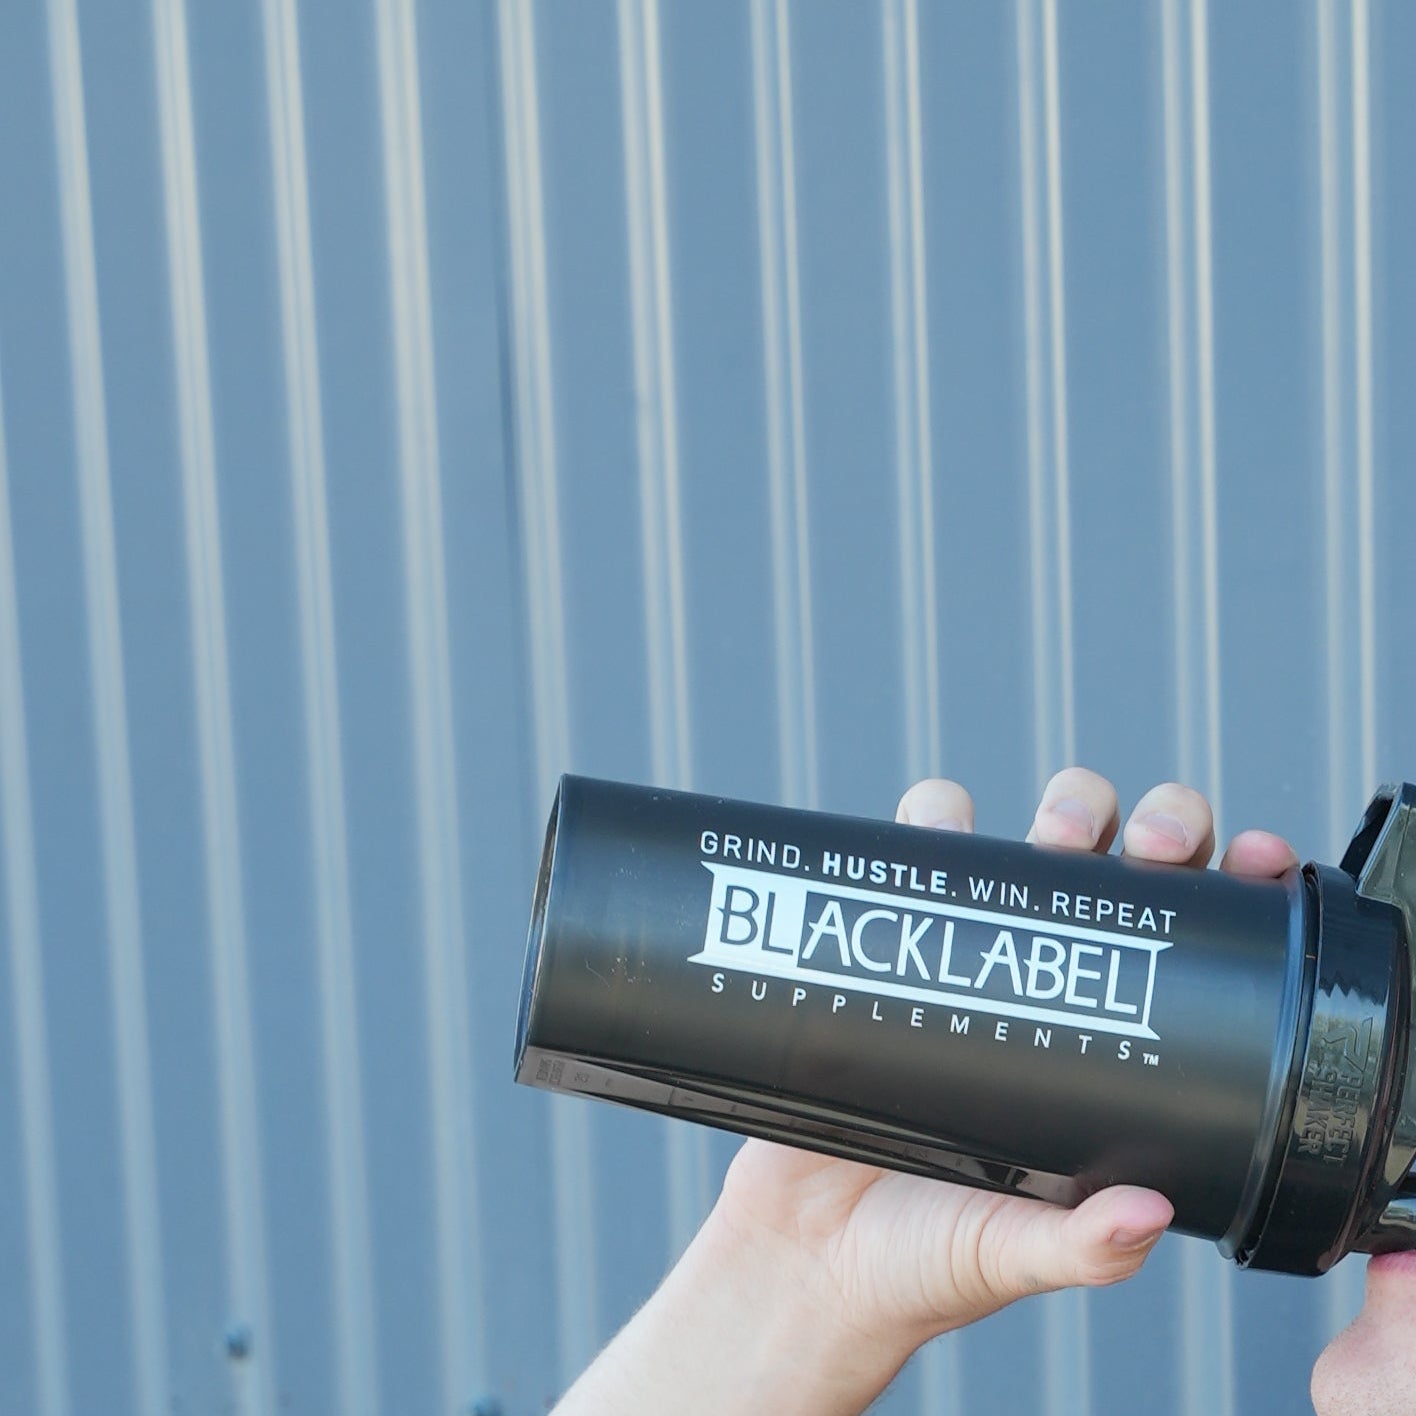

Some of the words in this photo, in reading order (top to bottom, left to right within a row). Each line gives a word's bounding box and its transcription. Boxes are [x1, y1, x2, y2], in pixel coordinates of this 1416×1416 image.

[700, 830, 810, 872] GRIND.
[821, 851, 957, 897] HUSTLE.
[968, 876, 1040, 912] WIN.
[1051, 891, 1177, 934] REPEAT
